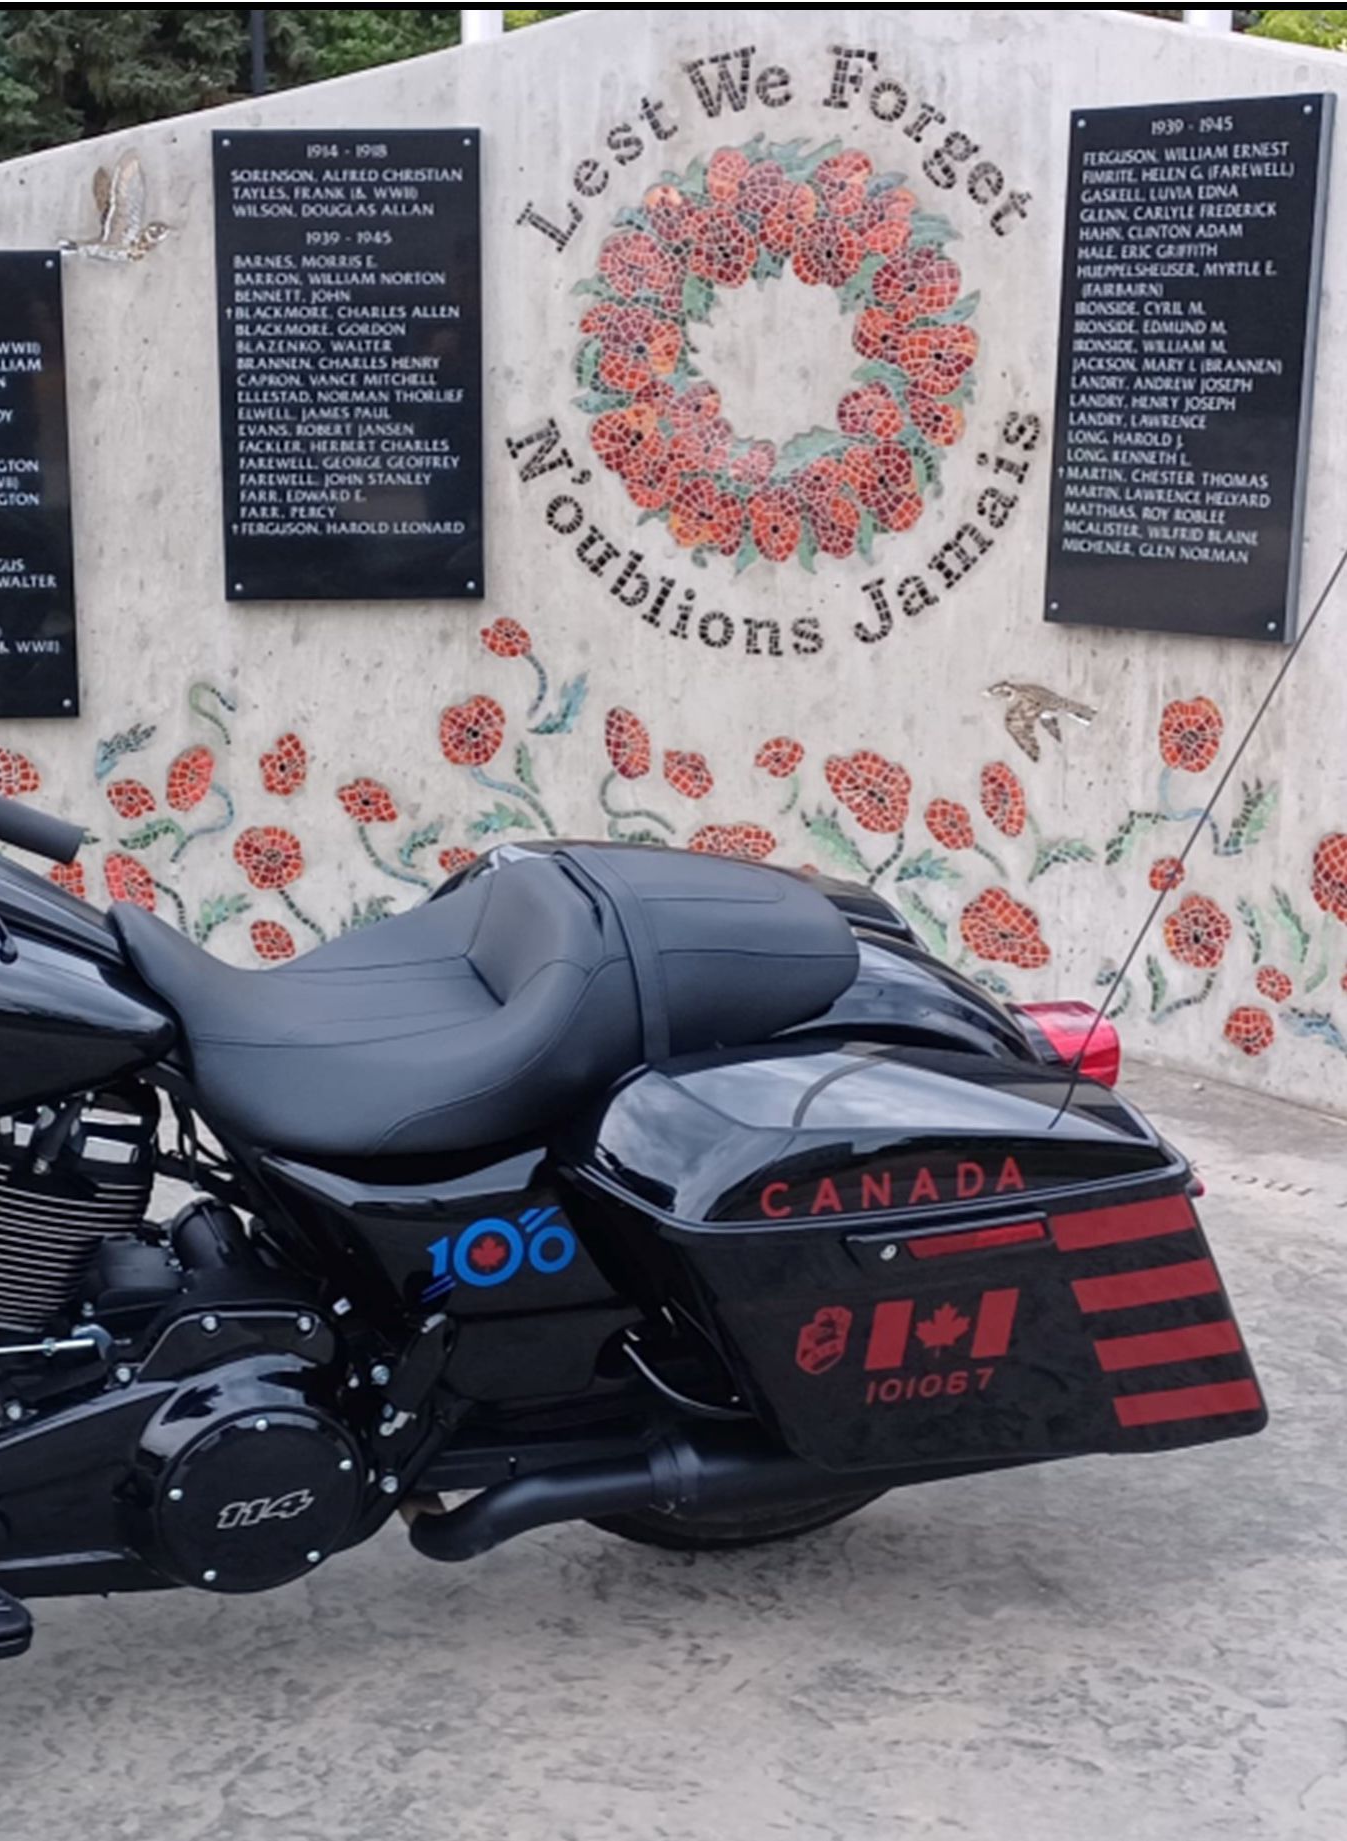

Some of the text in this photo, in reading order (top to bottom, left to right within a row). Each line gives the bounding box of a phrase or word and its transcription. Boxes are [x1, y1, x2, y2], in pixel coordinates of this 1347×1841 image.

[1152, 119, 1184, 135] 1939
[1200, 116, 1233, 132] 1945
[307, 145, 338, 157] 1914
[356, 144, 387, 158] 1918
[516, 43, 1036, 255] Lest We Forget
[1165, 145, 1228, 161] WILLIAM
[1233, 142, 1289, 158] ERNEST
[323, 170, 379, 181] ALFRED
[382, 169, 462, 181] CHRISTIAN
[1142, 167, 1186, 181] HELEN
[1208, 162, 1294, 180] (FAREWELL)
[1198, 184, 1238, 199] EDNA
[302, 204, 376, 217] DOUGLAS
[382, 204, 433, 216] ALLAN
[307, 232, 340, 245] 1939
[358, 231, 392, 244] 1945
[1128, 224, 1191, 240] CLINTON
[1196, 224, 1242, 238] ADAM
[302, 255, 362, 268] MORRIS
[1204, 262, 1259, 276] MYRTLE
[308, 273, 375, 285] WILLIAM
[381, 272, 445, 285] NORTON
[311, 289, 350, 304] JOHN
[337, 306, 406, 318] CHARLES
[412, 306, 459, 318] ALLEN
[338, 323, 405, 336] GORDON
[331, 340, 392, 352] WALTER
[318, 357, 387, 369] CHARLES
[392, 357, 439, 369] HENRY
[309, 373, 356, 386] VANCE
[364, 373, 436, 385] MITCHELL
[1134, 376, 1196, 391] ANDREW
[1200, 378, 1252, 393] JOSEPH
[317, 391, 389, 403] NORMAN
[302, 407, 349, 422] JAMES
[354, 407, 390, 419] PAUL
[1131, 414, 1205, 429] LAWRENCE
[296, 423, 351, 436] ROBERT
[359, 424, 413, 438] JANSEN
[310, 440, 375, 452] HERBERT
[381, 440, 449, 452] CHARLES
[322, 456, 381, 469] GEORGE
[387, 456, 459, 469] GEOFFREY
[325, 473, 363, 487] JOHN
[368, 473, 431, 485] STANLEY
[1131, 469, 1194, 485] CHESTER
[1203, 472, 1268, 489] THOMAS
[287, 490, 350, 502] EDWARD
[291, 506, 336, 518] PERCY
[327, 522, 389, 534] HAROLD
[393, 521, 464, 534] LEONARD
[854, 409, 1045, 646] Jamais
[759, 1156, 1027, 1219] CANADA
[421, 1206, 576, 1304] 100
[864, 1367, 996, 1405] 101067
[216, 1488, 316, 1530] 114
